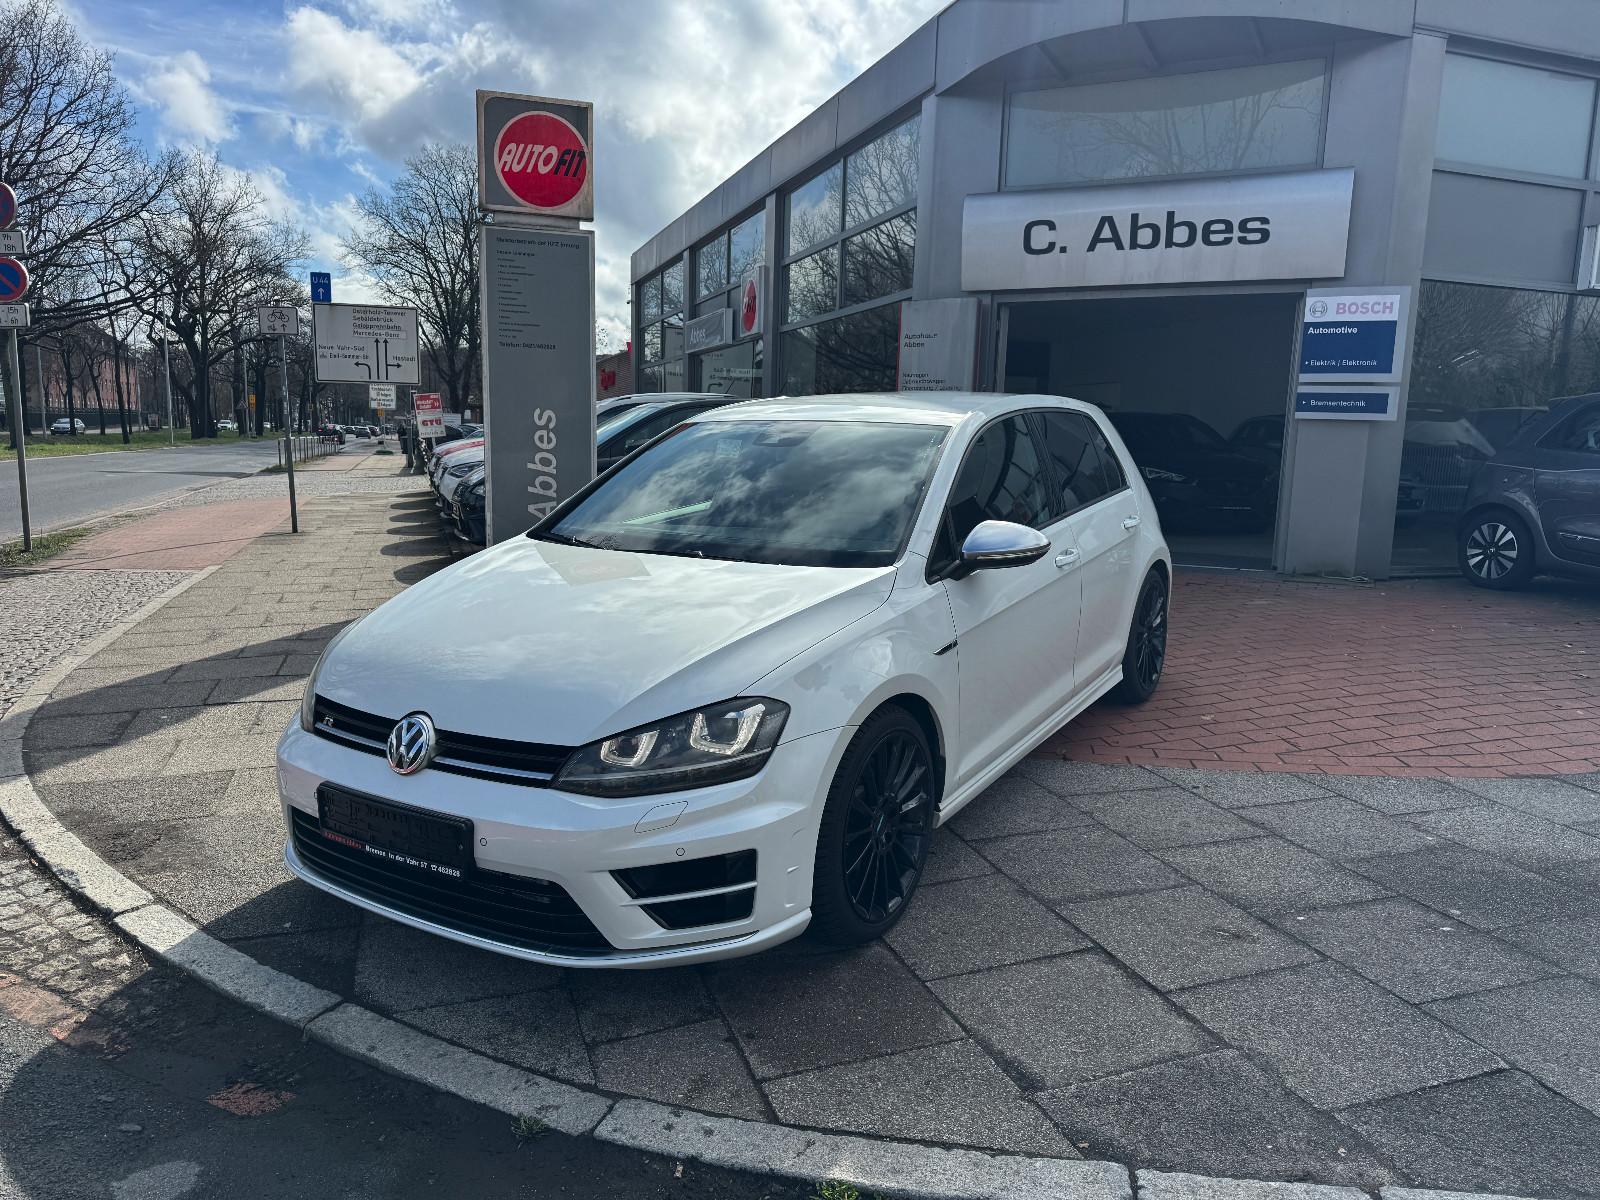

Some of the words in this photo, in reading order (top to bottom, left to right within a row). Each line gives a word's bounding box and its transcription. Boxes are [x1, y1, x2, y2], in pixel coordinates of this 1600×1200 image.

[500, 143, 586, 177] AUTOFIT
[1023, 219, 1067, 256] C.
[1086, 211, 1271, 253] Abbes
[1335, 301, 1394, 315] BOSCH
[1307, 325, 1358, 335] Automotive
[1310, 359, 1336, 367] Elektrik
[1341, 359, 1378, 367] Elektronik
[1310, 399, 1367, 408] Bremsentechnik
[527, 407, 557, 520] Abbes
